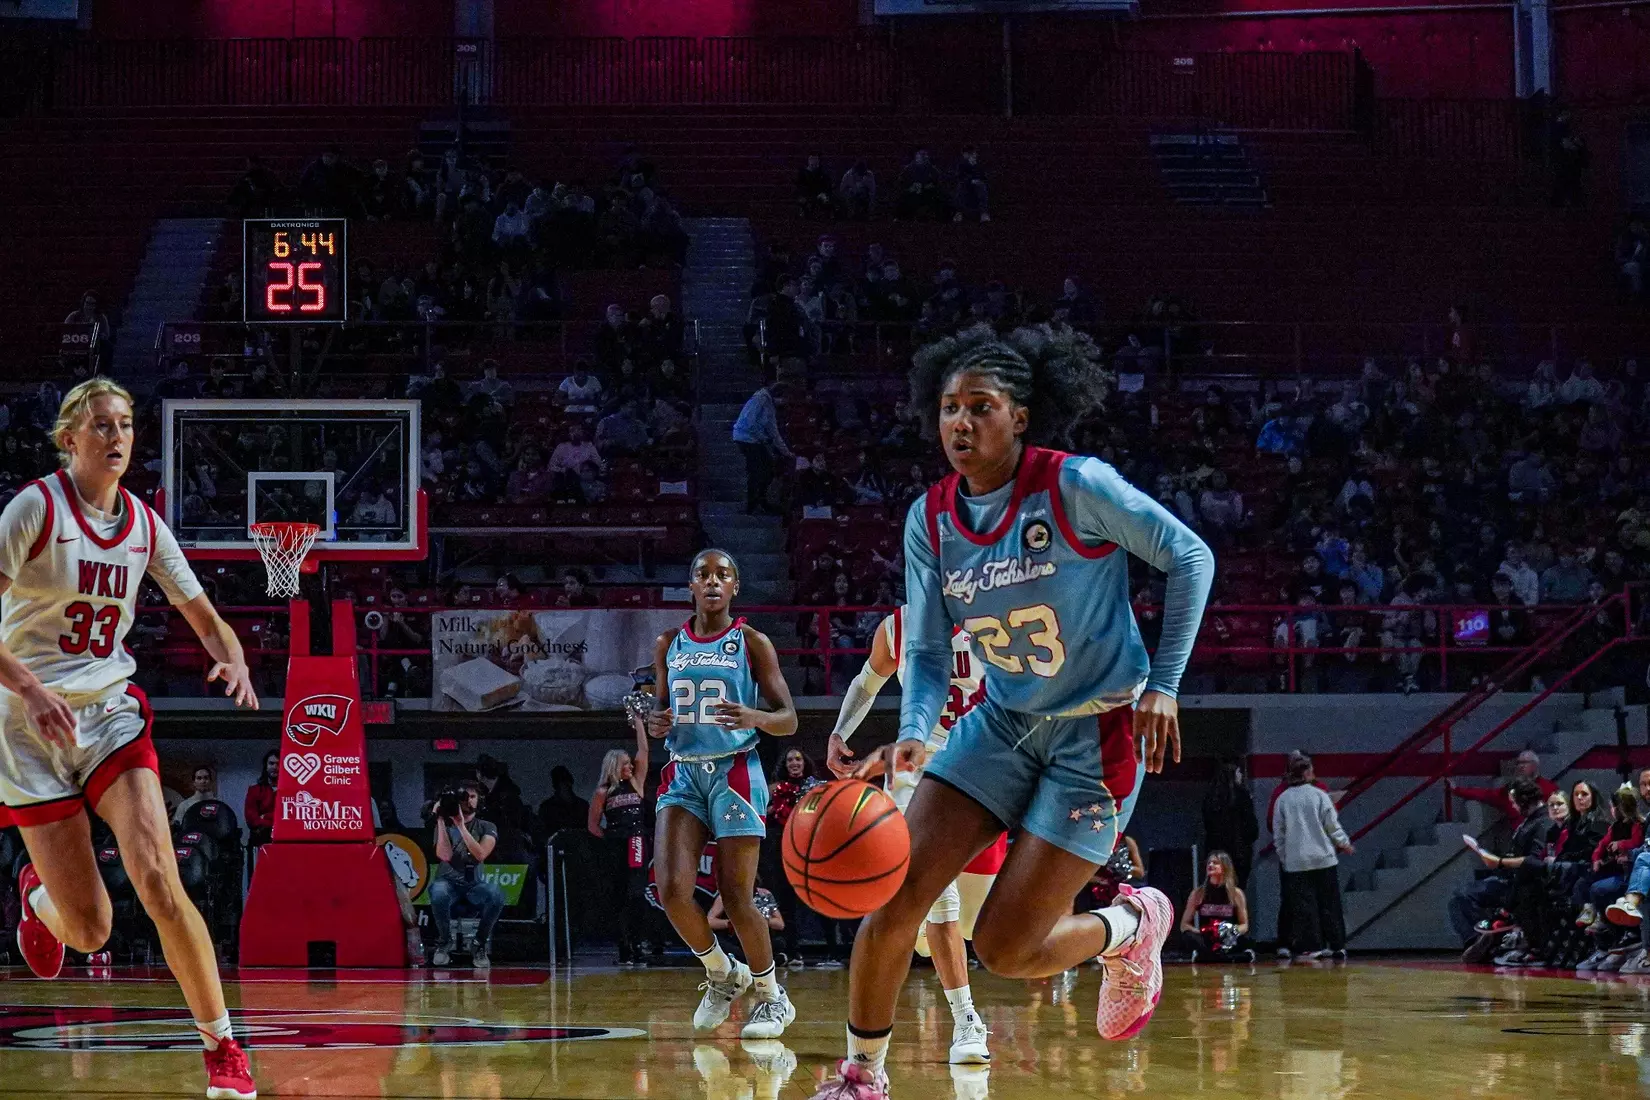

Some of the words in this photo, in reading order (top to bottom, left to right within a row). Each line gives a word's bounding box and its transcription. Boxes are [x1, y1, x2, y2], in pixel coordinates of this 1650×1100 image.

[267, 262, 325, 311] 25
[78, 559, 128, 599] WKU
[942, 567, 978, 605] Lady
[978, 555, 1057, 592] Techsters
[58, 601, 121, 659] 33
[1458, 618, 1485, 631] 110
[438, 638, 500, 655] Natural
[507, 638, 588, 655] Goodness
[962, 603, 1067, 678] 23
[671, 678, 727, 724] 22
[304, 703, 337, 720] WKU
[323, 753, 360, 764] Graves
[323, 764, 360, 775] Gilbert
[323, 775, 352, 785] Clinic
[303, 820, 347, 830] MOVING
